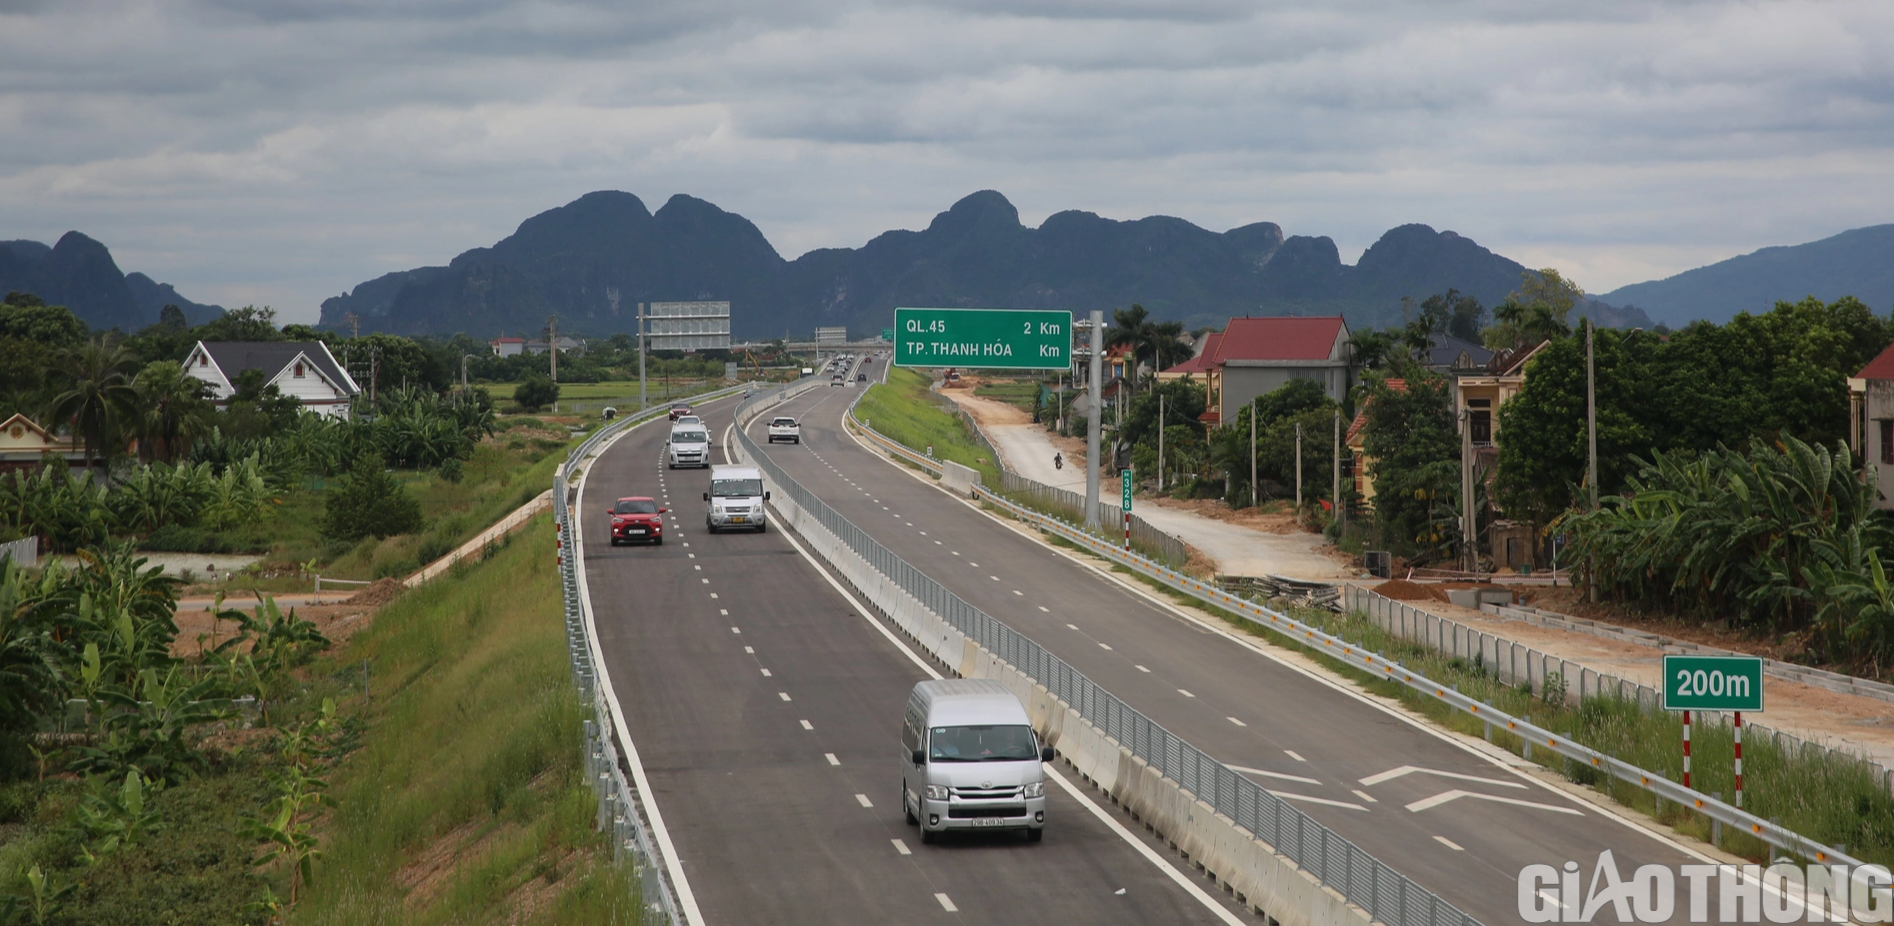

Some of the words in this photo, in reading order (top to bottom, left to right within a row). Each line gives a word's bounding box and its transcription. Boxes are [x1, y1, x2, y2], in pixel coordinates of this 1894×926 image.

[906, 319, 946, 333] QL.45
[1023, 321, 1031, 335] 2
[1040, 322, 1060, 335] Km
[983, 338, 1013, 356] HÓA
[1039, 344, 1060, 357] Km
[1677, 669, 1750, 697] 200m
